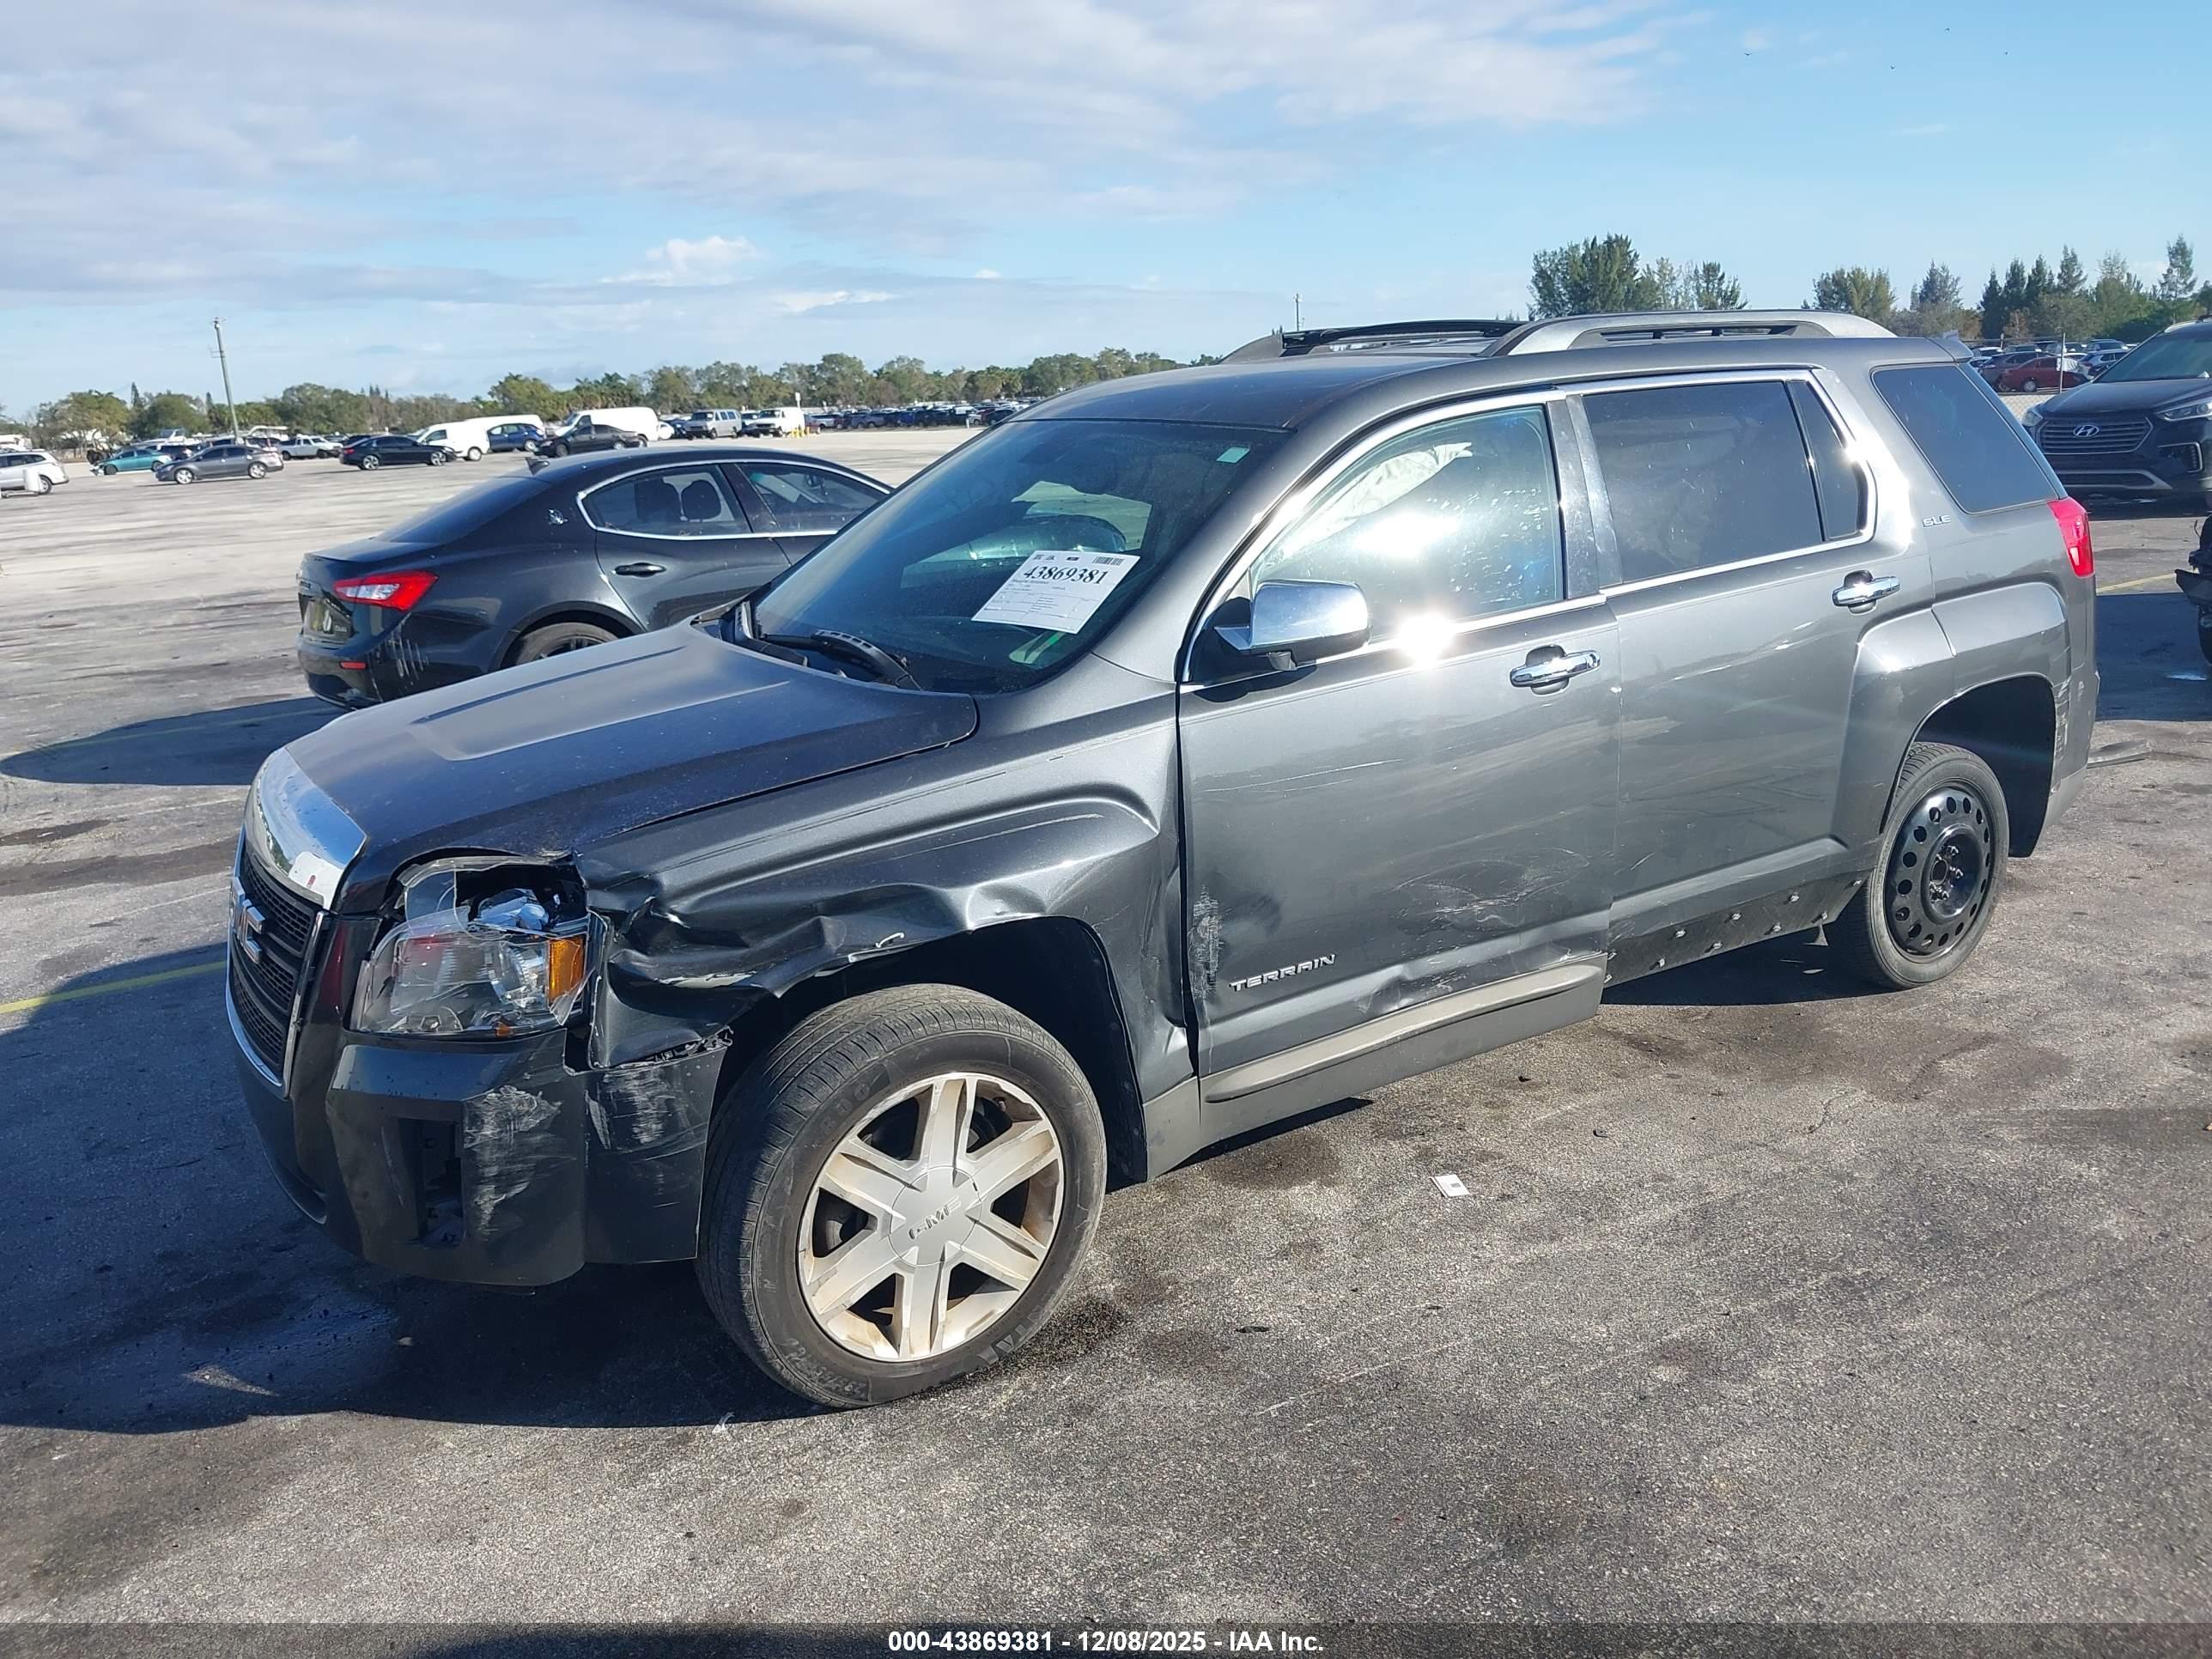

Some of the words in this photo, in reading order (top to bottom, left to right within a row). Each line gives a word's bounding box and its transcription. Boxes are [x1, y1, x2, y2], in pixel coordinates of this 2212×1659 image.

[1923, 514, 1952, 527] SLE
[1023, 565, 1109, 585] 43869381
[1228, 954, 1337, 992] TERRAIN
